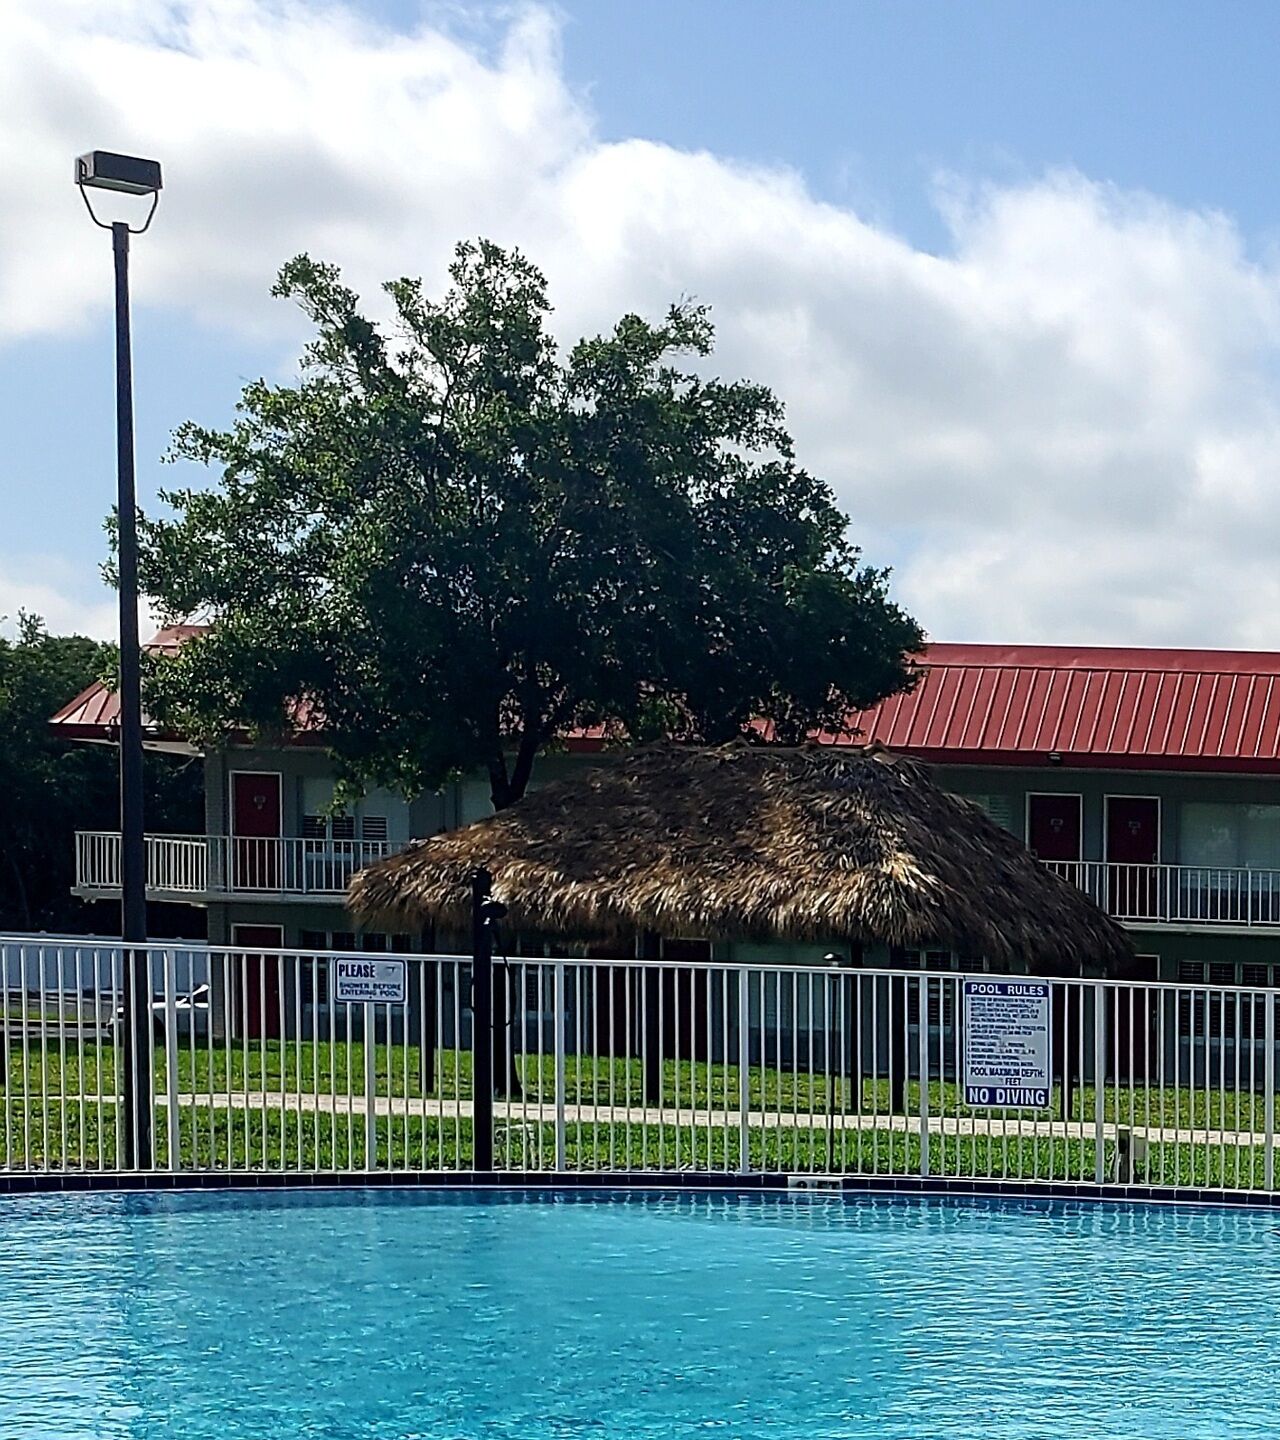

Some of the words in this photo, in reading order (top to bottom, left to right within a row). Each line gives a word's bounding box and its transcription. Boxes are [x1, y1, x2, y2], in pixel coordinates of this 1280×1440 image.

[338, 963, 376, 978] PLEASE
[970, 984, 1002, 994] POOL
[1007, 985, 1044, 996] RULES
[970, 1066, 988, 1076] POOL
[989, 1067, 1020, 1077] MAXIMUM
[1005, 1077, 1022, 1086] FEET
[969, 1087, 990, 1104] NO
[996, 1088, 1045, 1105] DIVING
